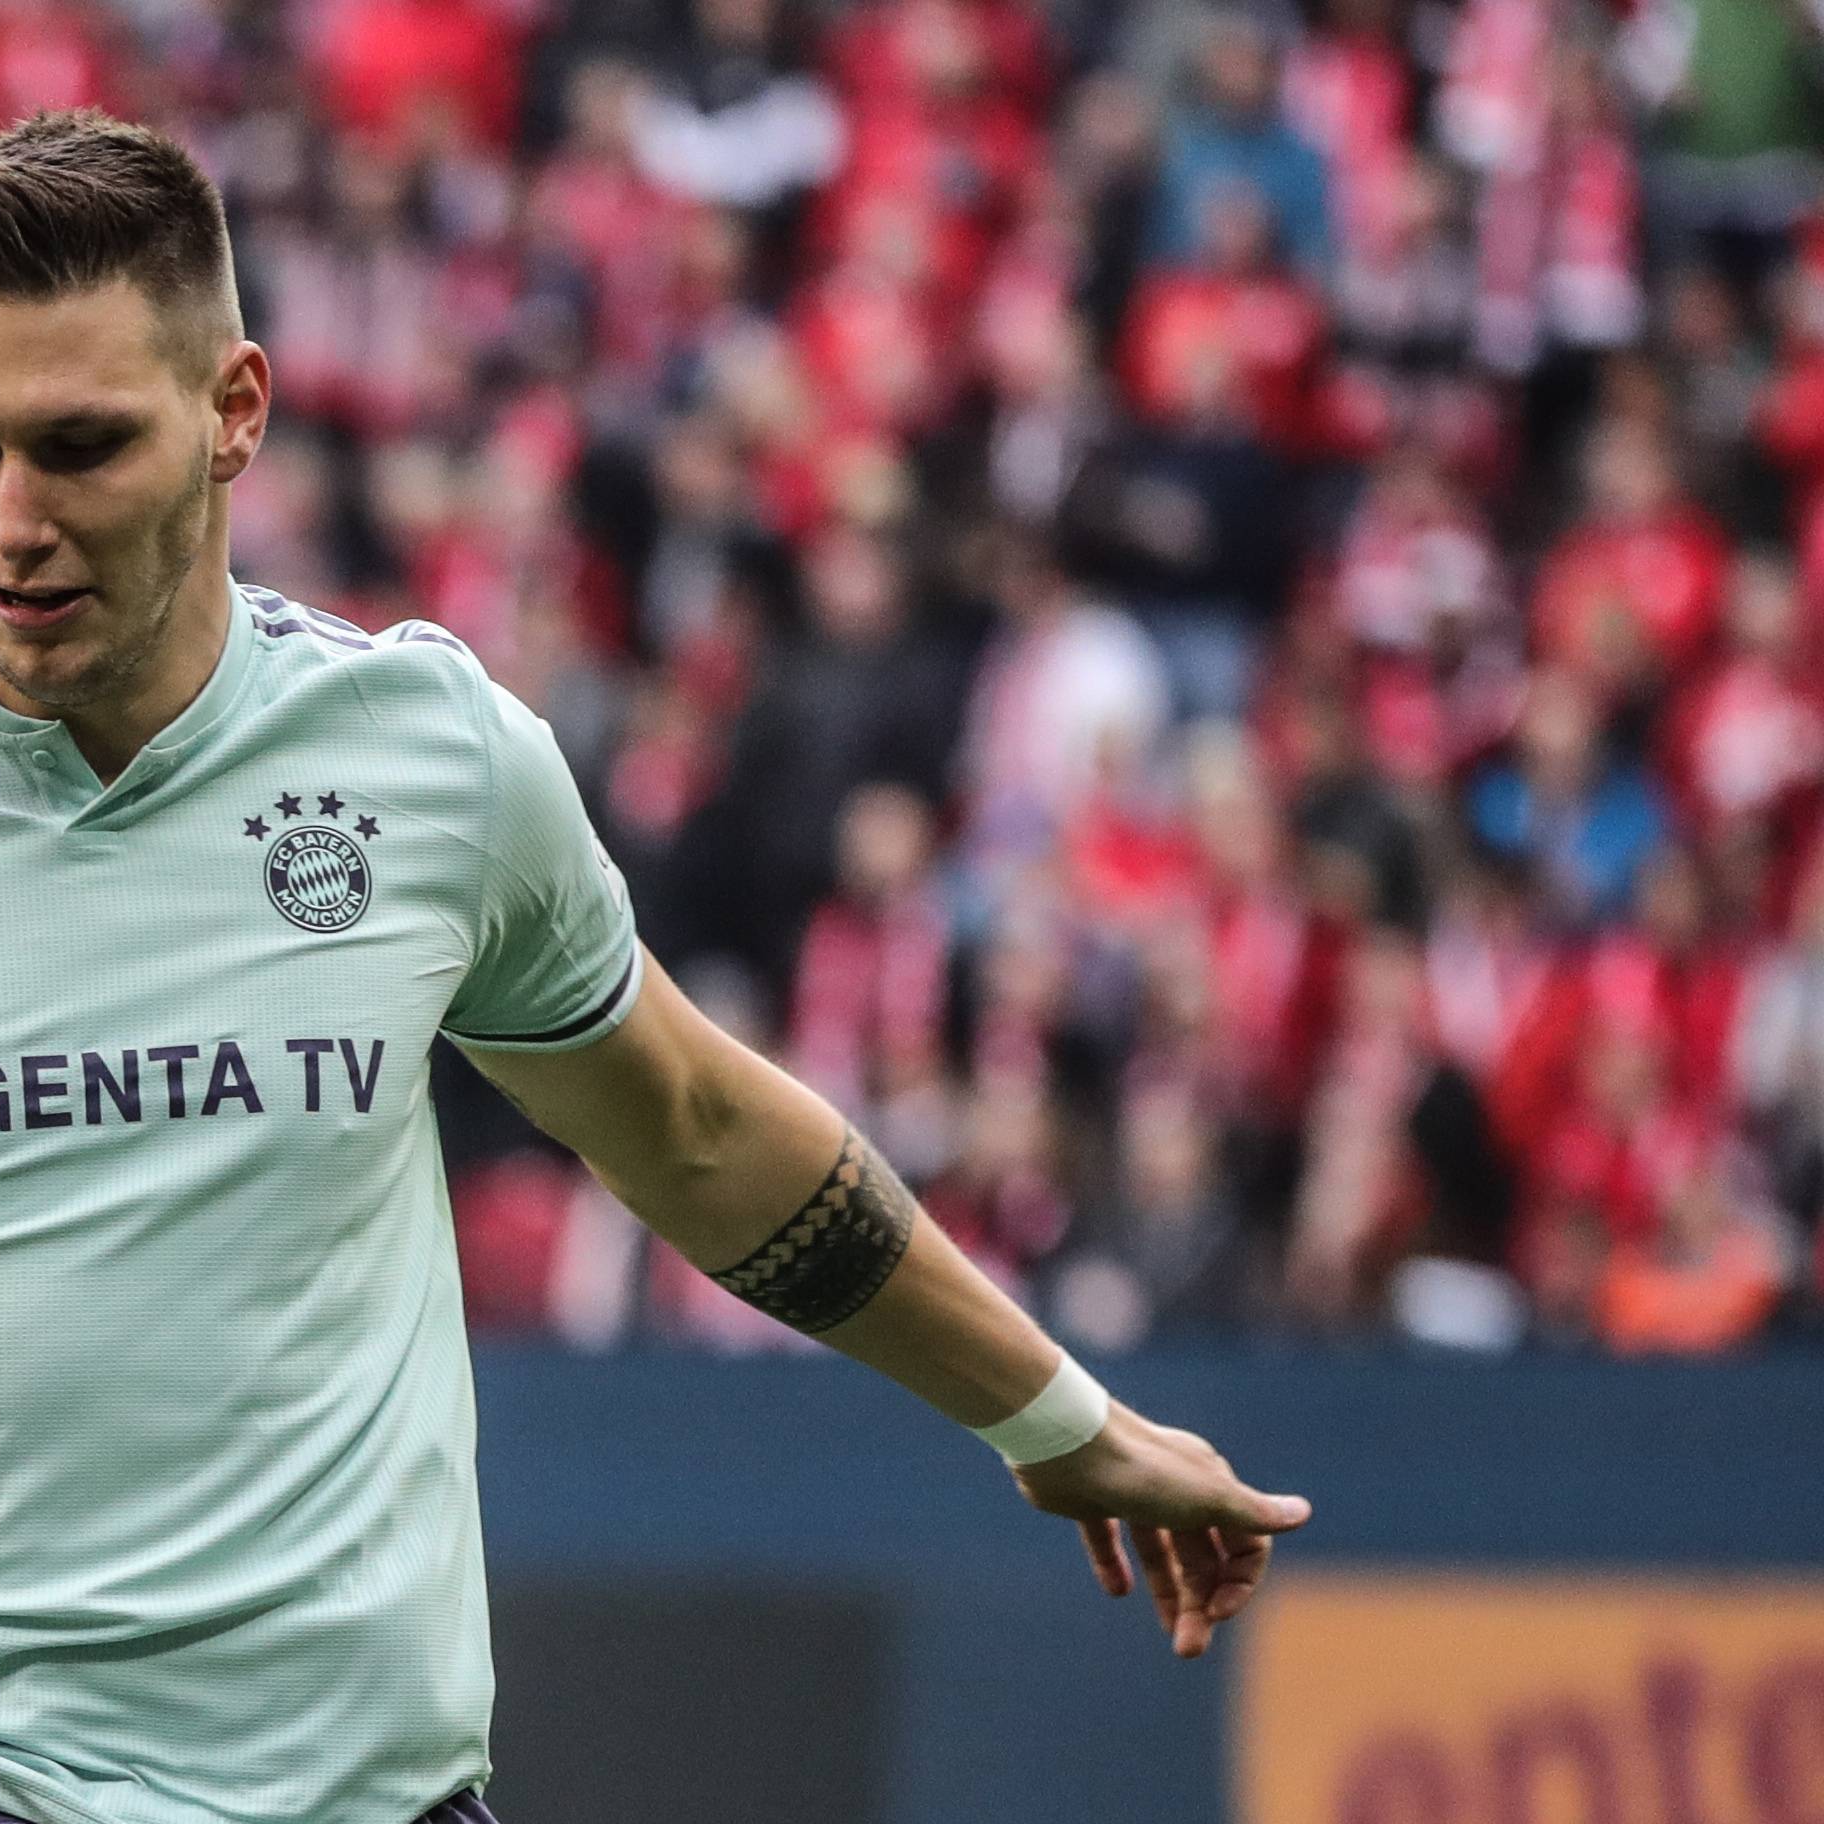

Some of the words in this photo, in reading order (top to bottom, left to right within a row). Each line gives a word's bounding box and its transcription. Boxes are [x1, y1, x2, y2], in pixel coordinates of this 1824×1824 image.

[272, 846, 293, 872] FC
[290, 831, 362, 873] BAYERN
[286, 1038, 386, 1115] TV
